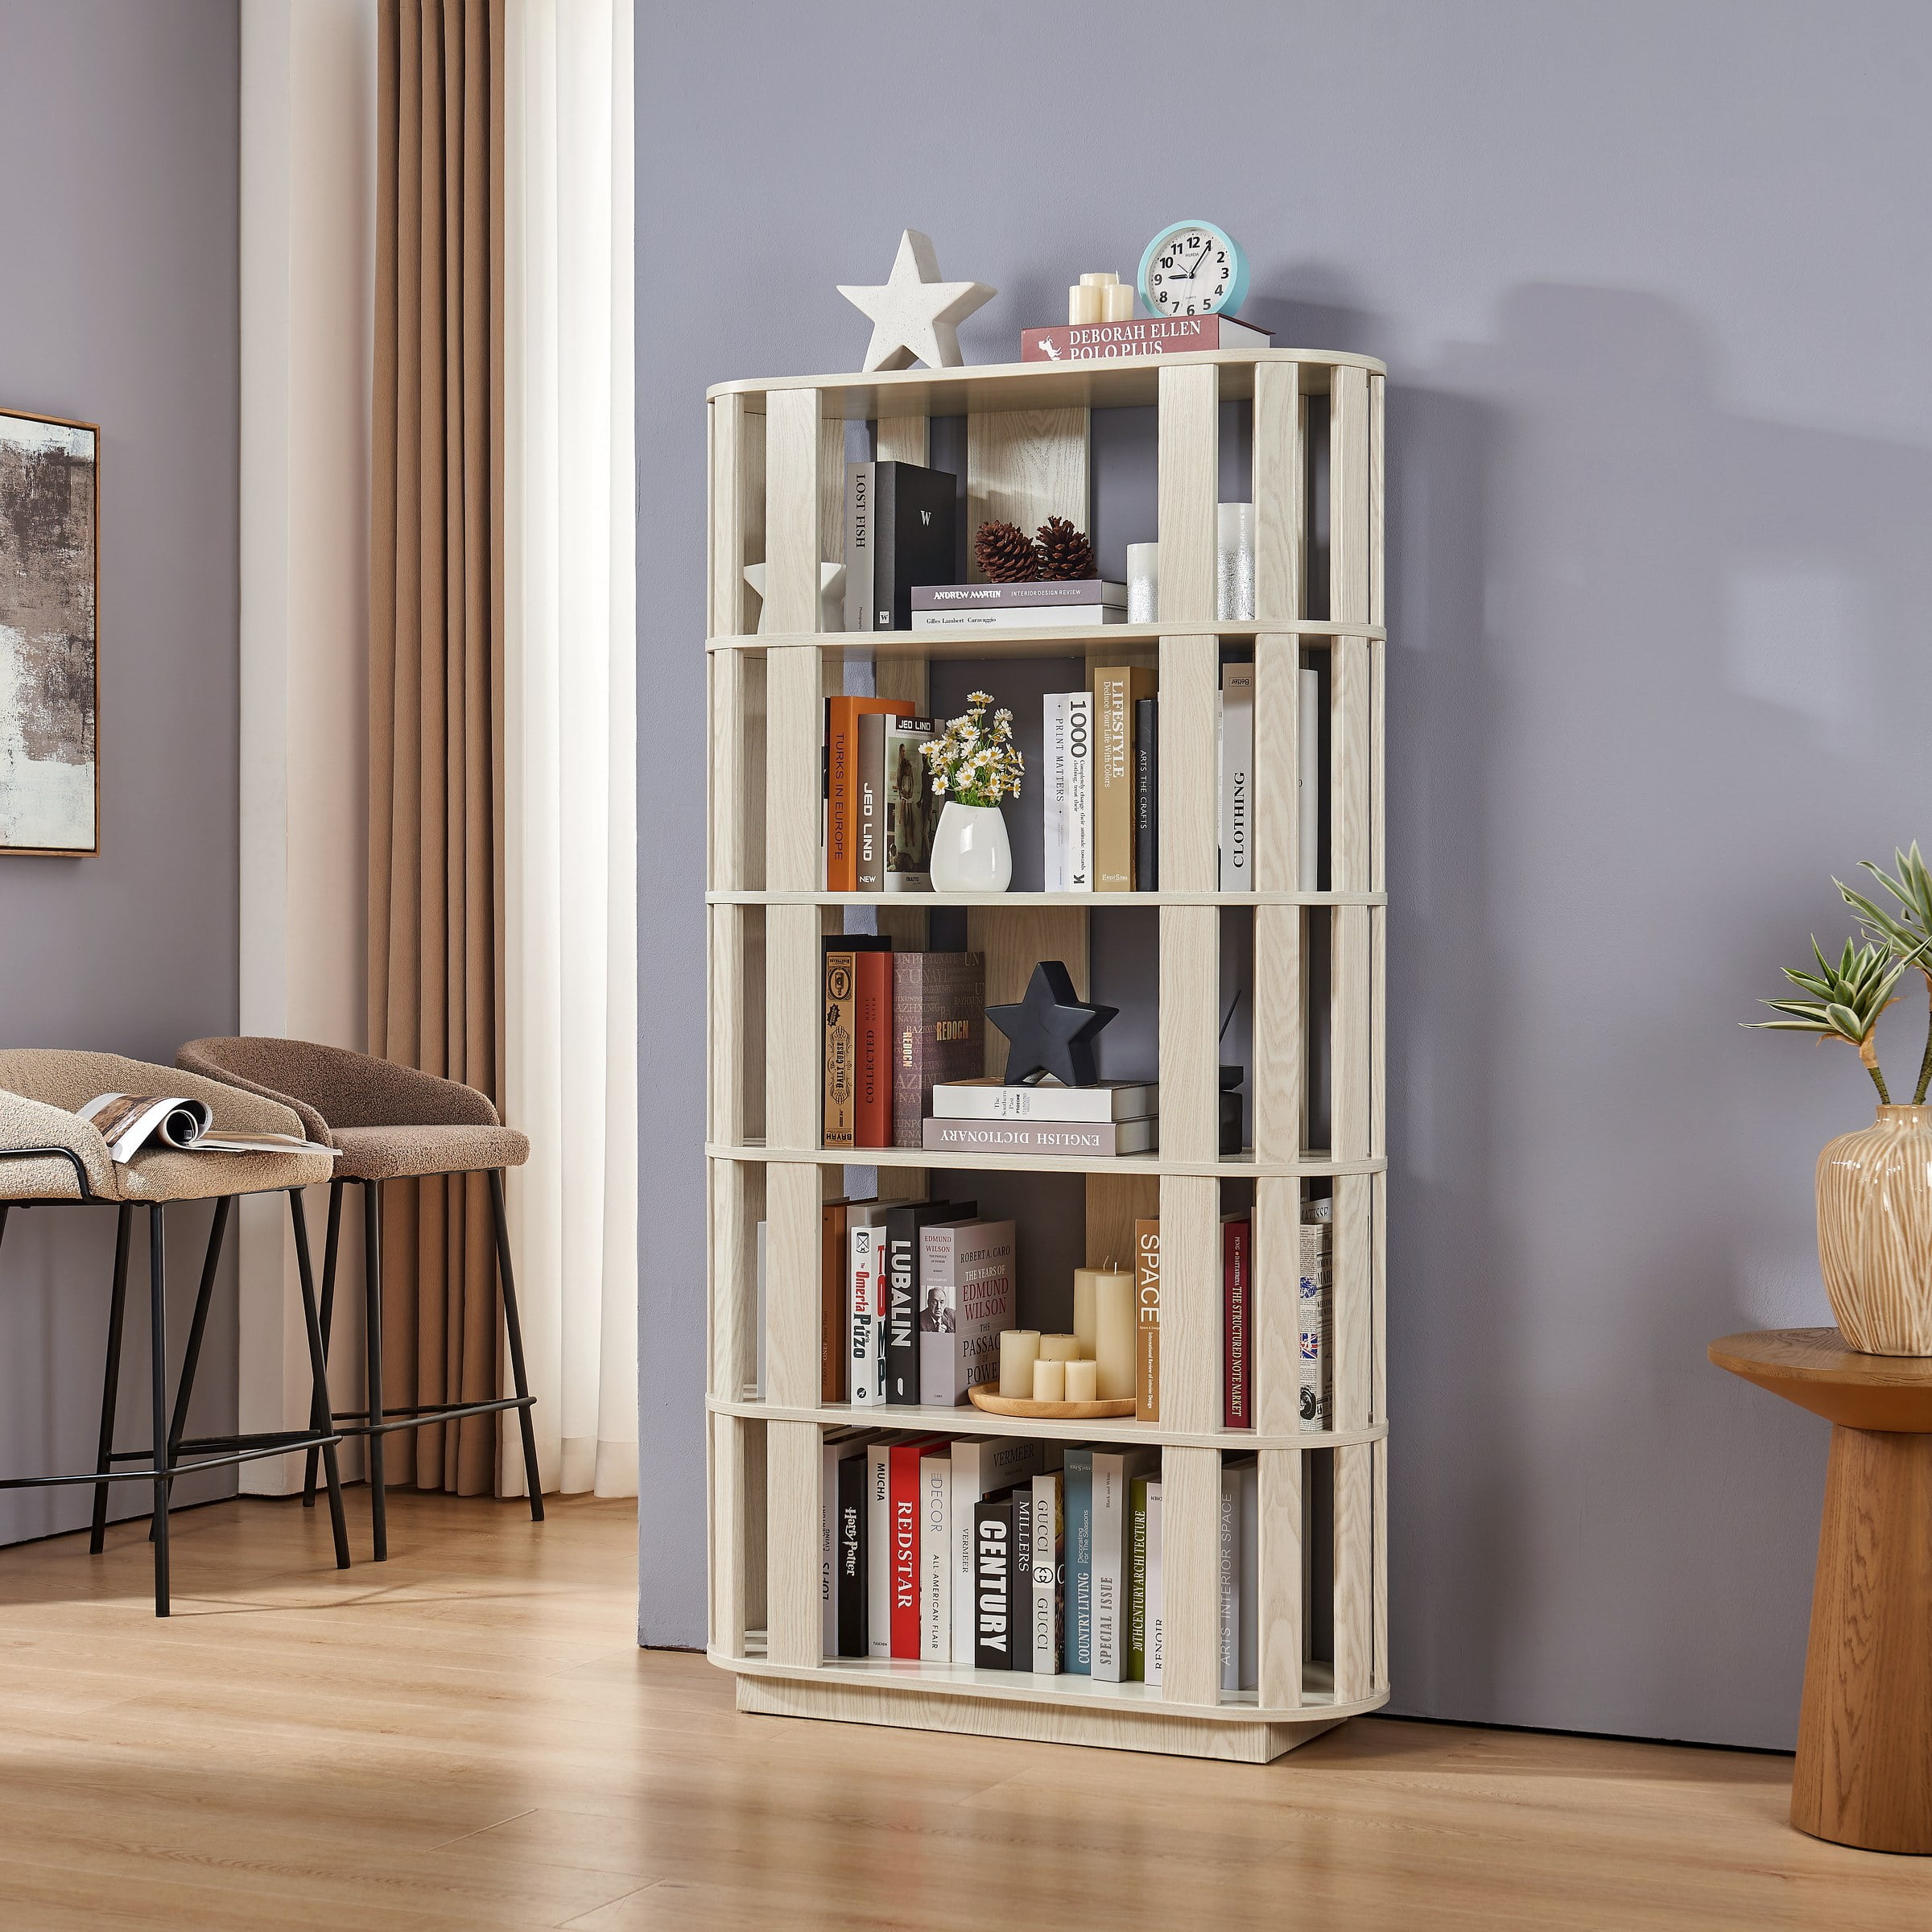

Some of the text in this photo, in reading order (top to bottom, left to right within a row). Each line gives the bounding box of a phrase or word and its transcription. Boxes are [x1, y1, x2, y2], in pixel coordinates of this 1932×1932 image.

[1170, 243, 1183, 255] 11
[1187, 237, 1200, 249] 12
[1159, 257, 1174, 269] 10
[1216, 251, 1225, 263] 2
[1154, 274, 1162, 286] 9
[1220, 267, 1229, 279] 3
[1159, 291, 1168, 303] 8
[1214, 284, 1224, 296] 4
[1171, 301, 1180, 313] 7
[1187, 304, 1195, 316] 6
[1203, 299, 1212, 311] 5
[1069, 320, 1201, 345] DEBORAH ELLEN
[1070, 341, 1162, 361] POLO PLUS
[856, 473, 866, 548] LOST FISH
[920, 510, 932, 526] W
[933, 591, 969, 601] ANDREW
[970, 590, 1001, 599] MARTIN
[880, 613, 889, 621] W
[967, 617, 997, 625] Caravaggio
[898, 720, 931, 731] JED LIND
[1070, 700, 1088, 758] 1000
[1104, 709, 1112, 726] Your
[1112, 680, 1125, 778] LIFESTYLE
[1104, 726, 1112, 744] Life
[1055, 718, 1065, 803] PRINT MATTERS
[1104, 745, 1112, 762] With
[1104, 763, 1112, 788] Colors
[834, 733, 844, 861] TURKS IN EUROPE
[1139, 749, 1148, 830] ARTS THE CRAFTS
[862, 782, 873, 862] JED LIND
[1232, 770, 1245, 869] CLOTHING
[859, 875, 877, 883] NEW
[935, 1020, 969, 1042] REDOCN
[902, 1031, 913, 1068] REDOCN
[836, 1041, 845, 1089] DAILY CURSE
[865, 1030, 875, 1104] COLLECTED
[940, 1129, 1100, 1146] ENGLISH DICTIONARY
[924, 1235, 952, 1243] EDMUND
[960, 1245, 1011, 1264] ROBERT A. CARO
[965, 1265, 1006, 1282] THE YEARS OF
[1140, 1233, 1160, 1323] SPACE
[855, 1271, 870, 1312] Omerta
[890, 1240, 912, 1348] LUBALIN
[963, 1278, 1009, 1302] EDMUND
[1232, 1286, 1242, 1304] THE
[964, 1297, 1006, 1321] WILSON
[853, 1313, 872, 1359] Puzo
[979, 1322, 991, 1333] THE
[1232, 1304, 1242, 1358] STRUCTURED
[982, 1353, 989, 1363] OF
[967, 1361, 1001, 1385] POWE
[1232, 1359, 1242, 1382] NOTE
[993, 1443, 1035, 1468] VERMEER
[877, 1463, 886, 1501] MUCHA
[930, 1479, 943, 1534] DECOR
[1018, 1501, 1030, 1572] MILLERS
[1037, 1500, 1048, 1554] GUCCI
[842, 1506, 857, 1577] Harry Potter
[961, 1528, 969, 1574] VERMEER
[898, 1501, 914, 1609] REDSTAR
[978, 1519, 1008, 1653] CENTURY
[1221, 1493, 1232, 1666] ARTS INTERIOR SPACE
[1037, 1597, 1048, 1650] GUCCI
[1077, 1571, 1089, 1664] COUNTRY LIVING
[1100, 1577, 1113, 1665] SPECIAL ISSUE
[931, 1624, 939, 1649] FLAIR
